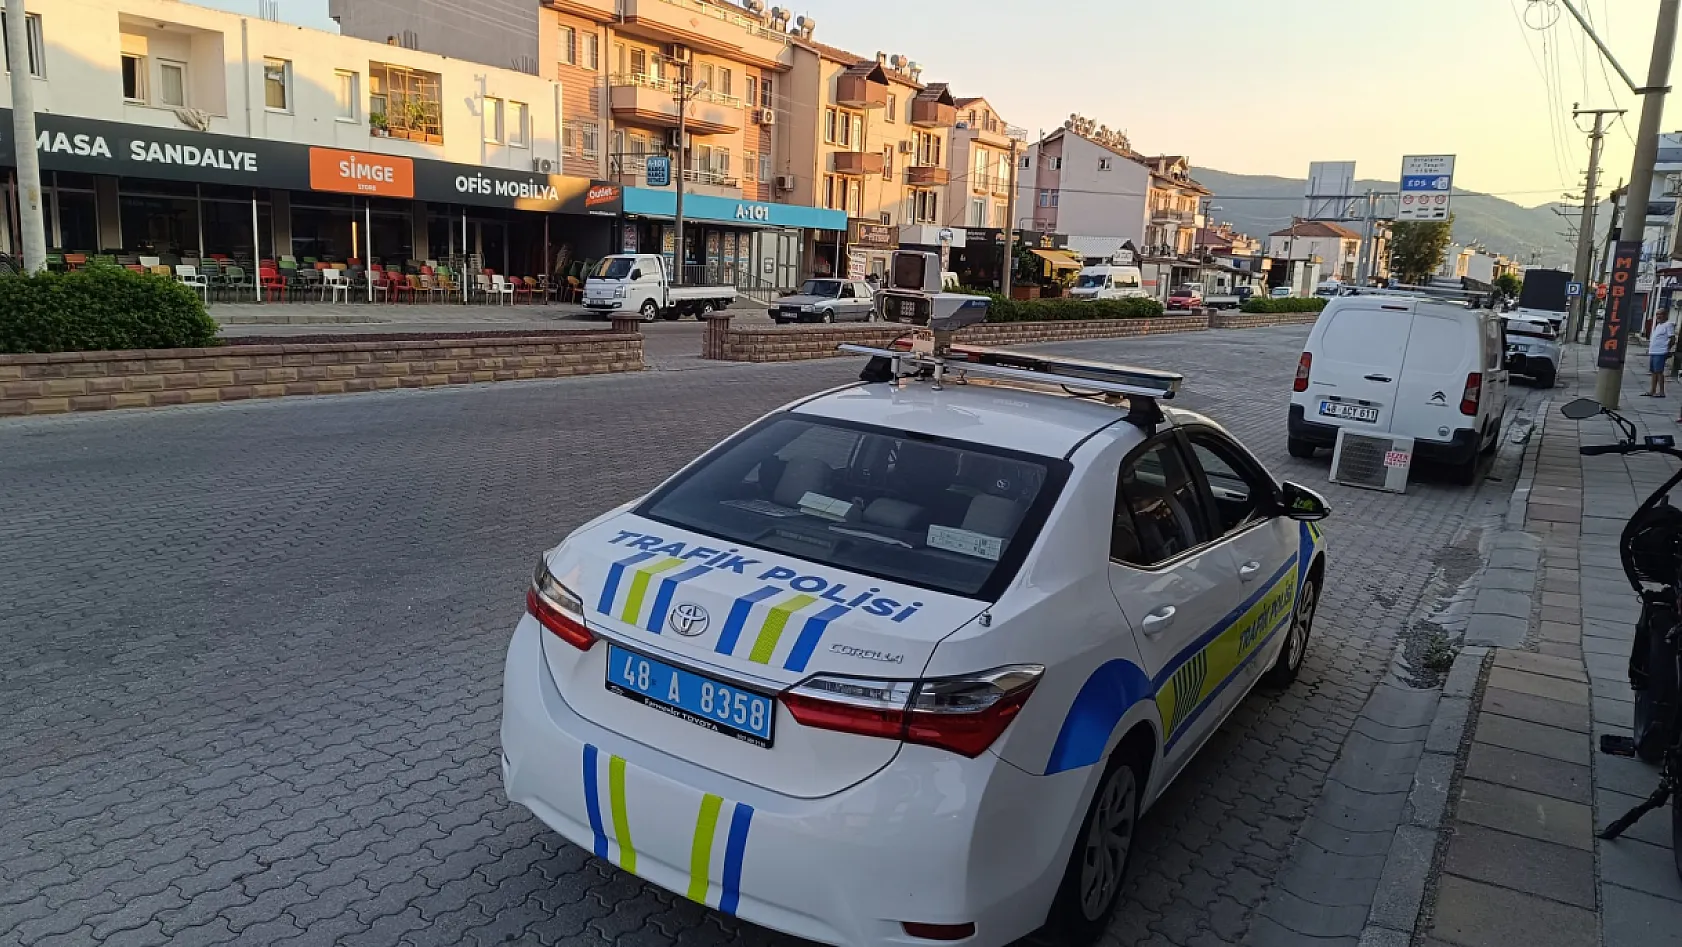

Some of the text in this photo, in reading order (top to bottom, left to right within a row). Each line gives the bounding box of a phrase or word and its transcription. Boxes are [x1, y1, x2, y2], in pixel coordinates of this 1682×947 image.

[35, 130, 258, 172] MASA SANDALYE
[338, 155, 394, 183] SİMGE
[1407, 179, 1427, 187] EDS
[357, 183, 376, 191] STORE
[455, 172, 559, 201] OFİS MOBİLYA
[1326, 403, 1336, 413] 48
[1359, 408, 1378, 420] 611
[608, 529, 924, 623] TRAFİK POLİSİ
[828, 643, 904, 664] COROLLA
[623, 655, 650, 691] 48
[668, 671, 681, 704] A
[701, 681, 766, 731] 8358
